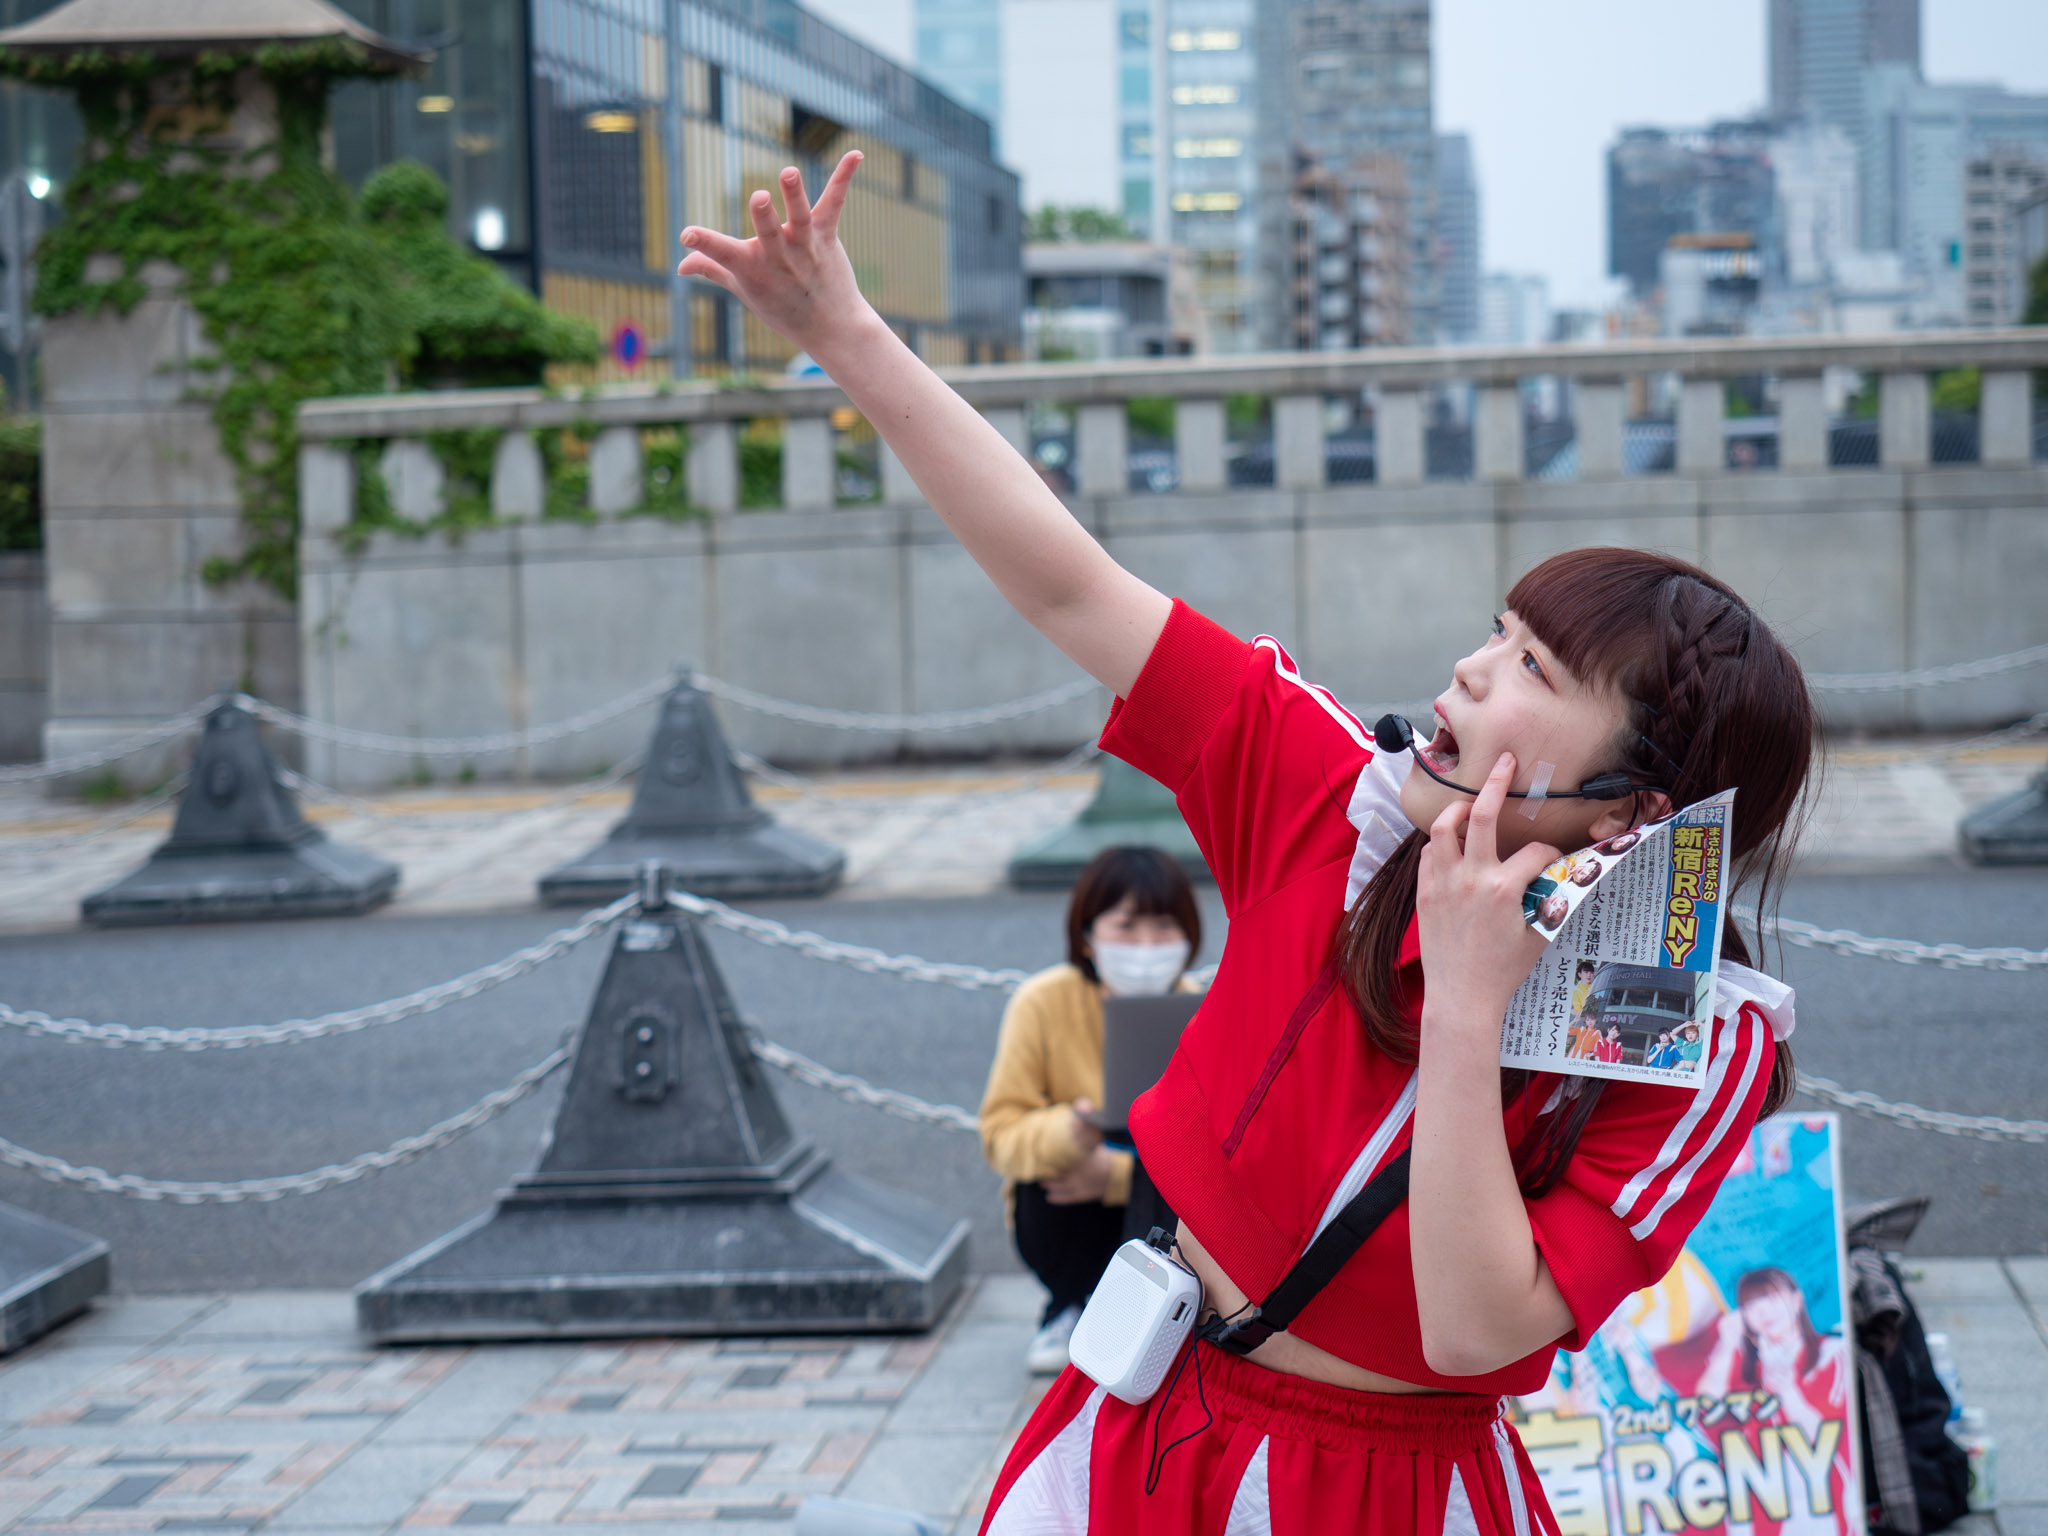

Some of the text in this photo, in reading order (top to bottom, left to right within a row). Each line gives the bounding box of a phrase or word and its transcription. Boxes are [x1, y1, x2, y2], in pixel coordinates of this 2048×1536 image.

[1668, 807, 1724, 825] イブ開催決定
[1664, 826, 1705, 965] 新宿ReNY
[1702, 826, 1721, 902] まさかまさかの
